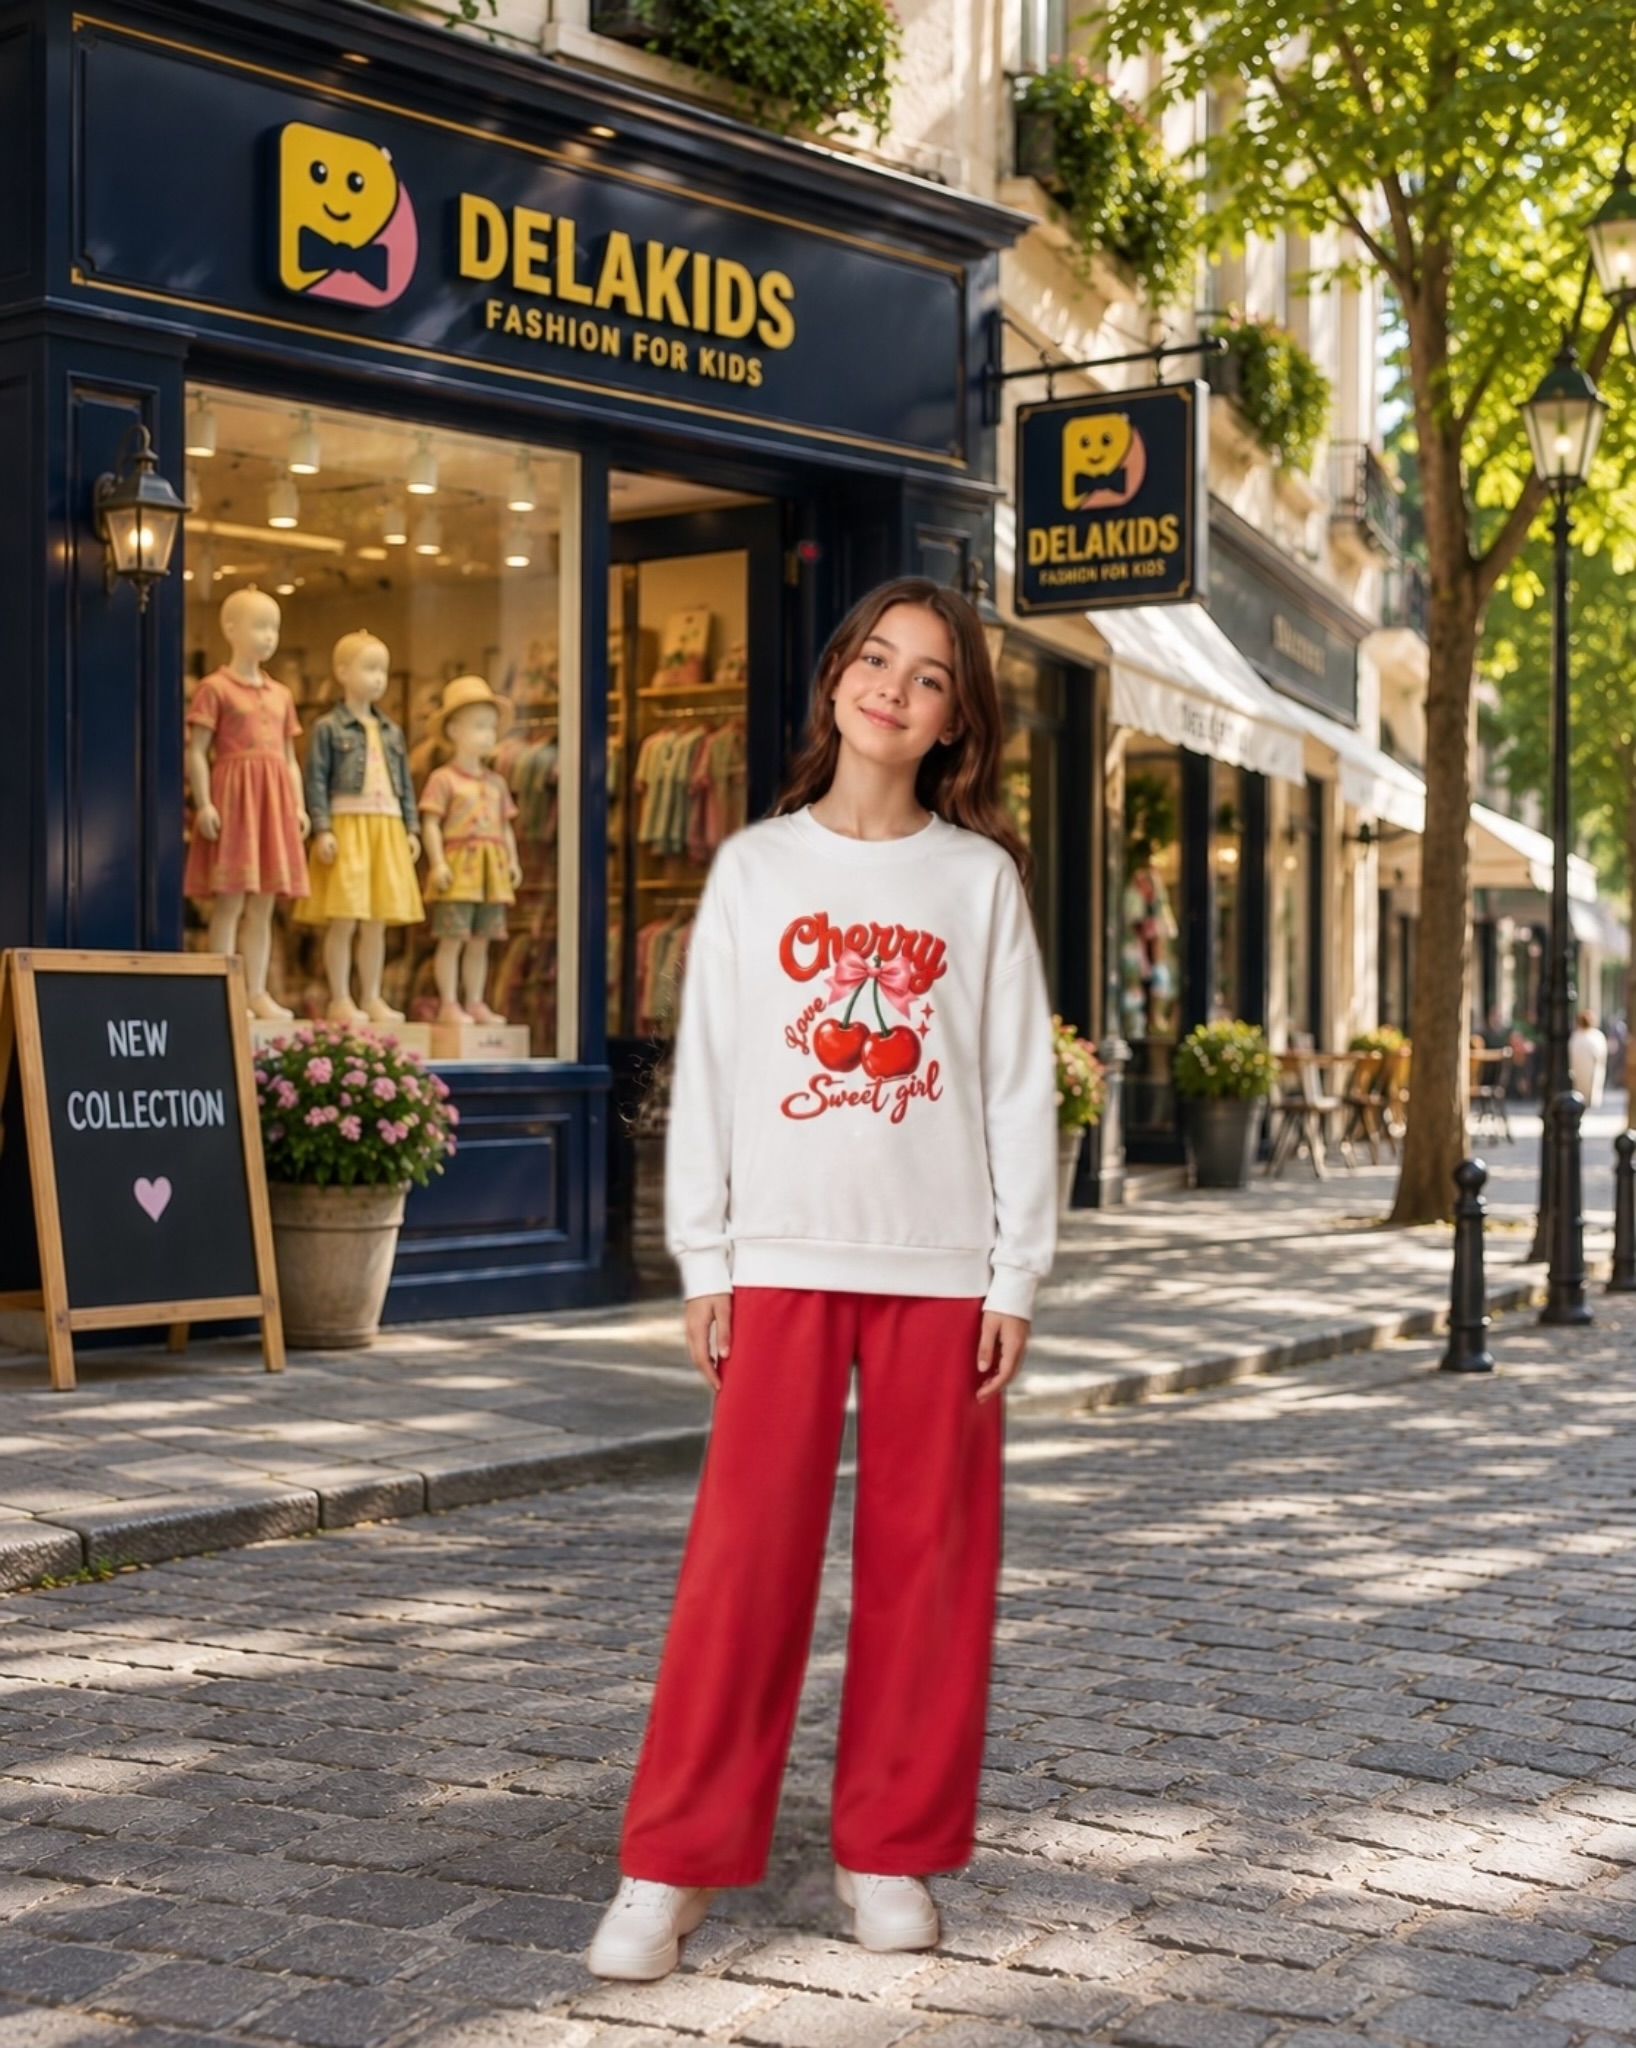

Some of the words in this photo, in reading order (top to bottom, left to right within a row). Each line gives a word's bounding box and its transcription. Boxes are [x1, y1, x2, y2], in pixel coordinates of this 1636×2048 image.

[459, 192, 796, 350] DELAKIDS
[486, 299, 621, 358] FASHION
[633, 332, 688, 372] FOR
[699, 347, 763, 387] KIDS
[1028, 513, 1179, 566] DELAKIDS
[1101, 562, 1129, 581] FOR
[1132, 559, 1166, 578] KIDS
[779, 911, 947, 995] Cherry
[107, 1019, 167, 1057] NEW
[785, 997, 826, 1055] Love
[67, 1089, 225, 1131] COLLECTION
[781, 1073, 907, 1120] Sweet
[890, 1060, 943, 1124] girl
